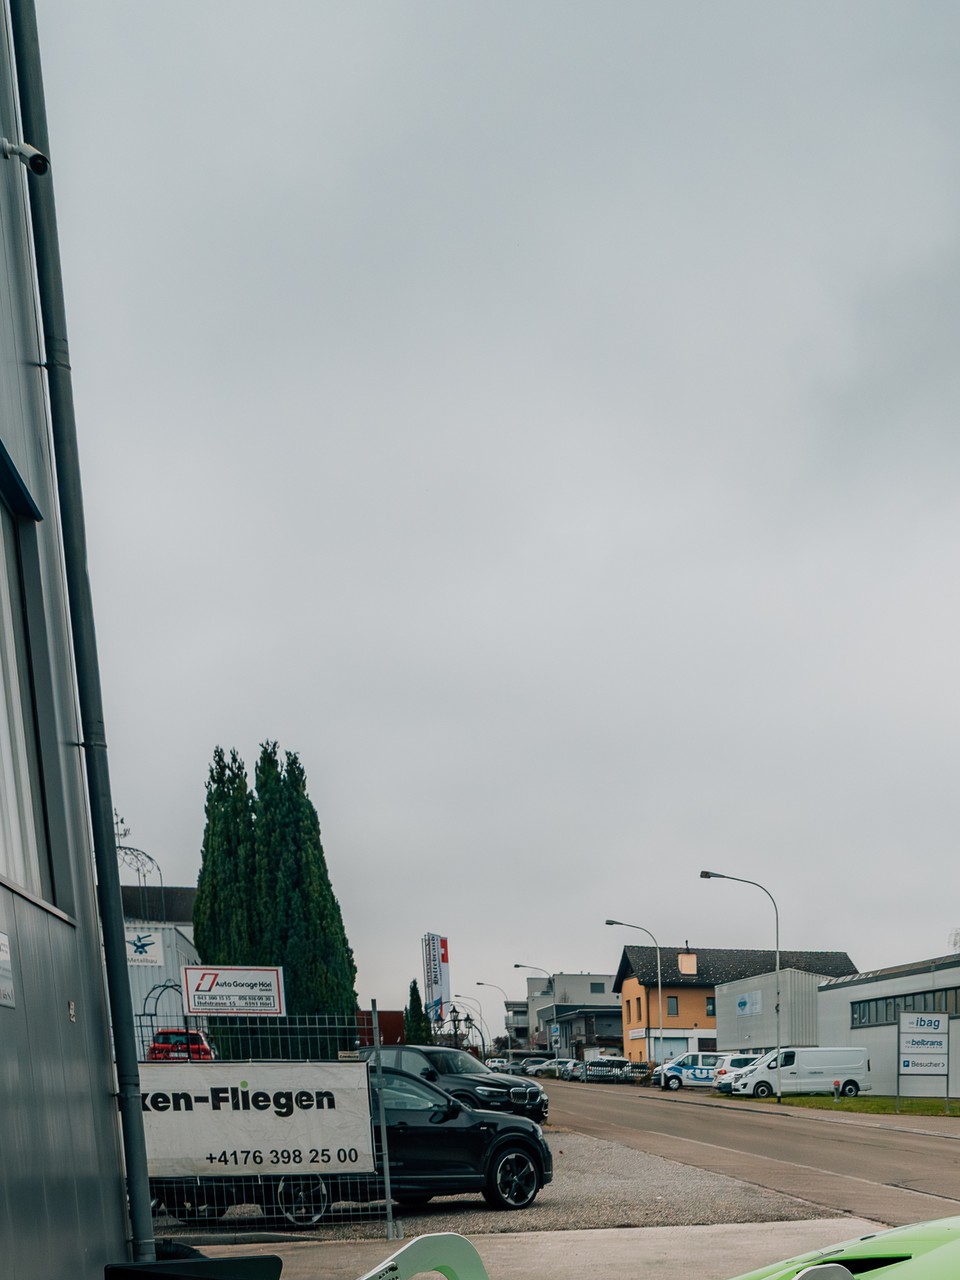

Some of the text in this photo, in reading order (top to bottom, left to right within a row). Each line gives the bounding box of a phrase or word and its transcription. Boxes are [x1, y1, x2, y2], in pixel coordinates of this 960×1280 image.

[214, 980, 232, 988] Auto
[233, 980, 258, 989] Garage
[915, 1017, 940, 1030] ibag
[206, 1148, 358, 1165] +4176 398 25 00
